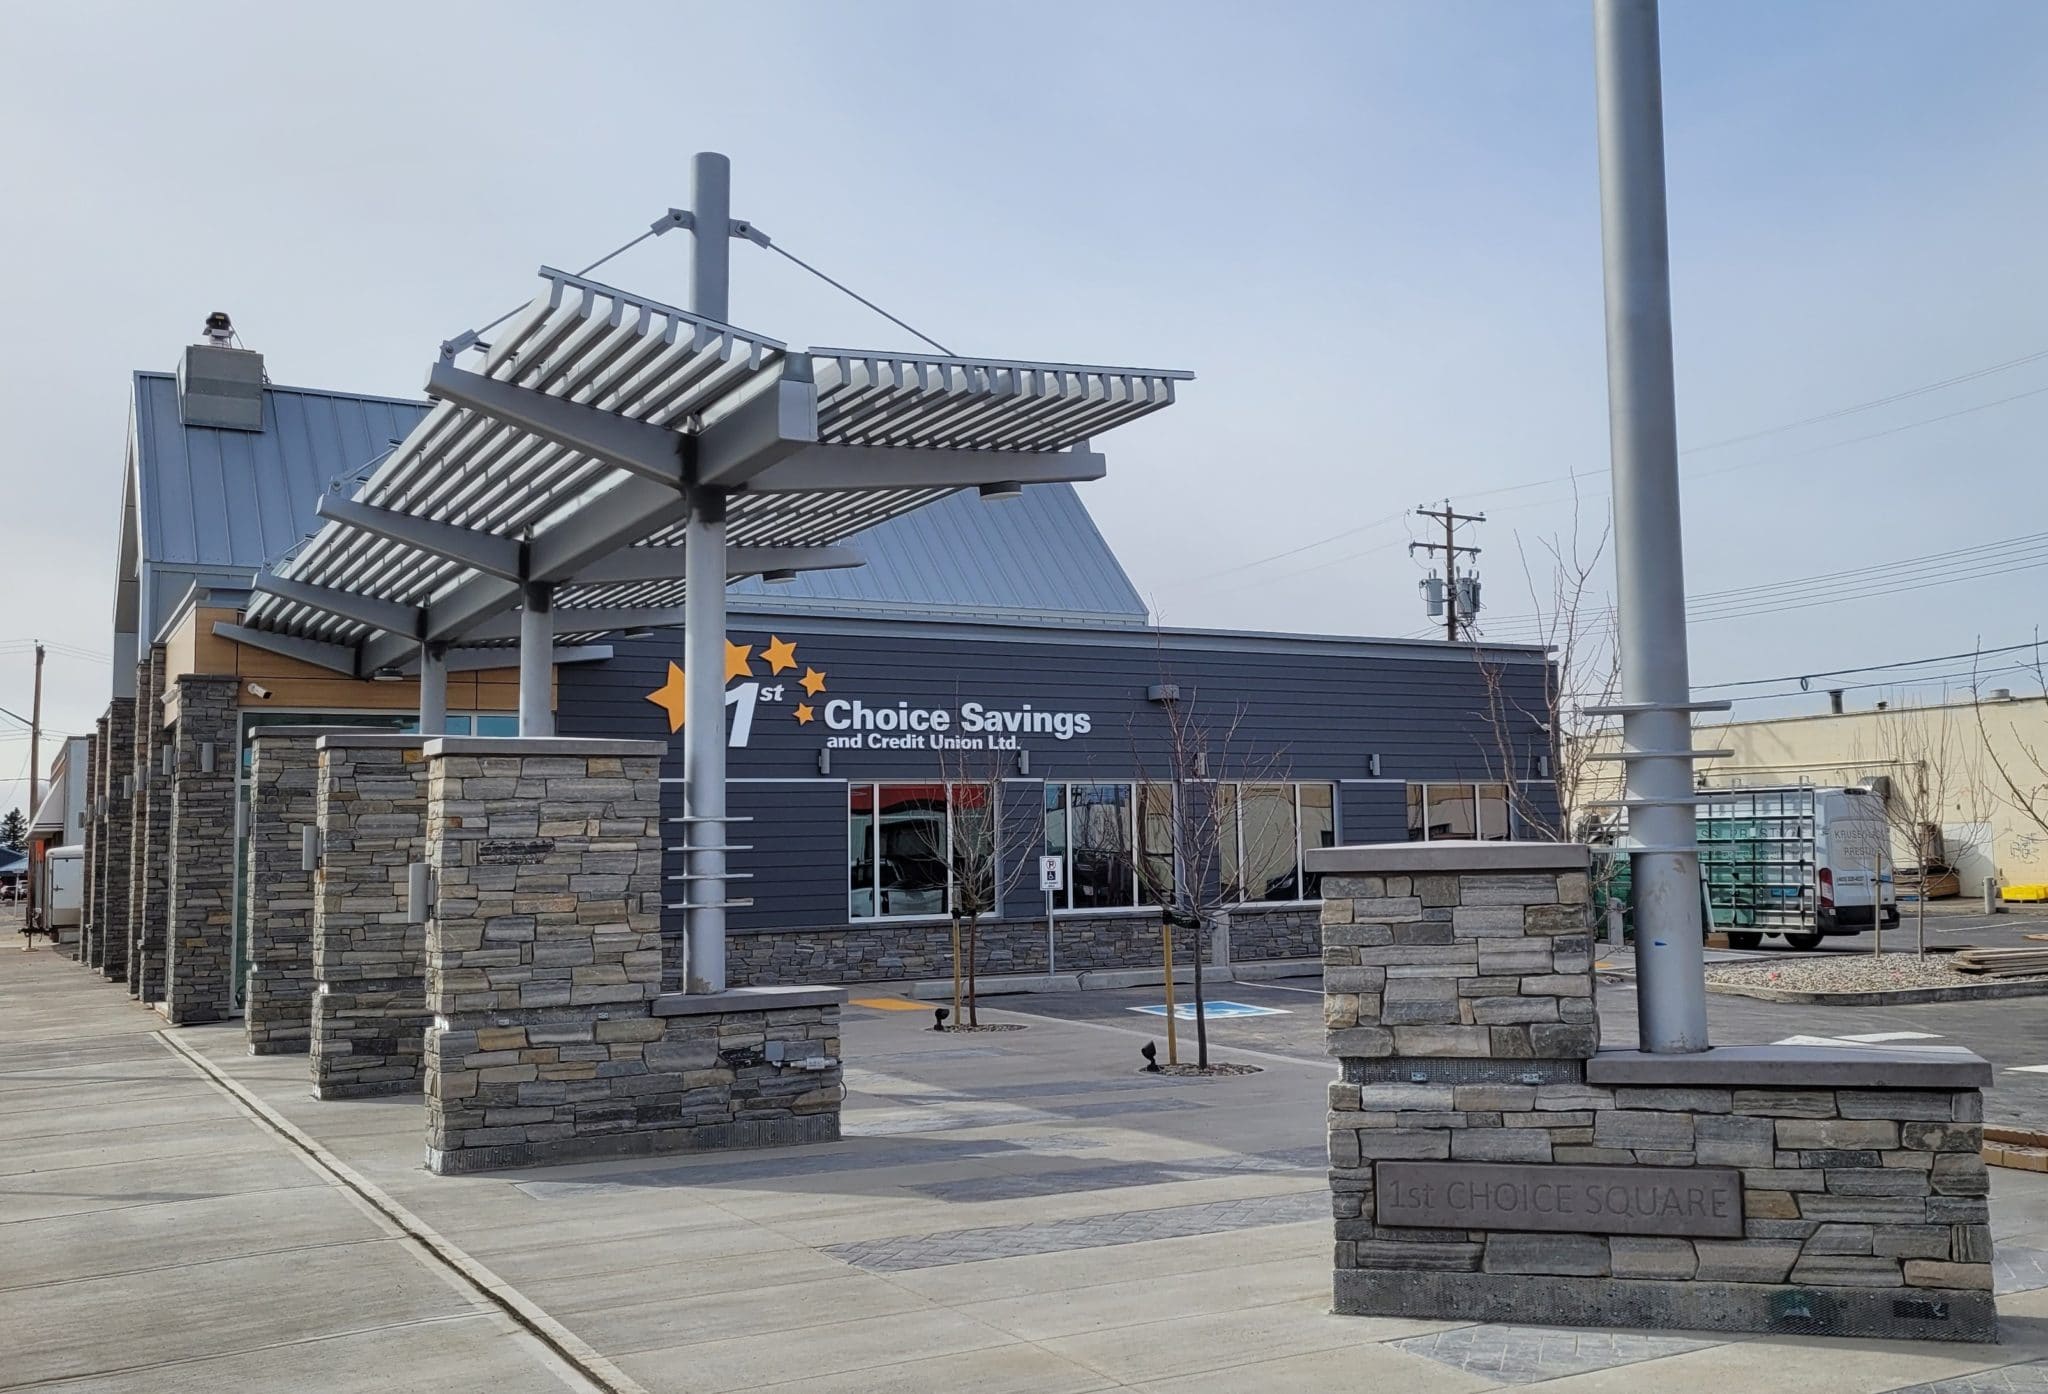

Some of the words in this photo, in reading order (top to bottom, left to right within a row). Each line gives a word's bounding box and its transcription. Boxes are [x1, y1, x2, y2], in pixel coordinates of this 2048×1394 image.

[824, 699, 951, 731] Choice
[961, 702, 1092, 740] Savings
[826, 734, 862, 749] and
[868, 734, 925, 750] Credit
[930, 735, 983, 750] Union
[987, 735, 1022, 751] Ltd.
[1388, 1180, 1435, 1210] 1st
[1446, 1182, 1576, 1215] CHOICE
[1586, 1184, 1729, 1219] SQUARE
